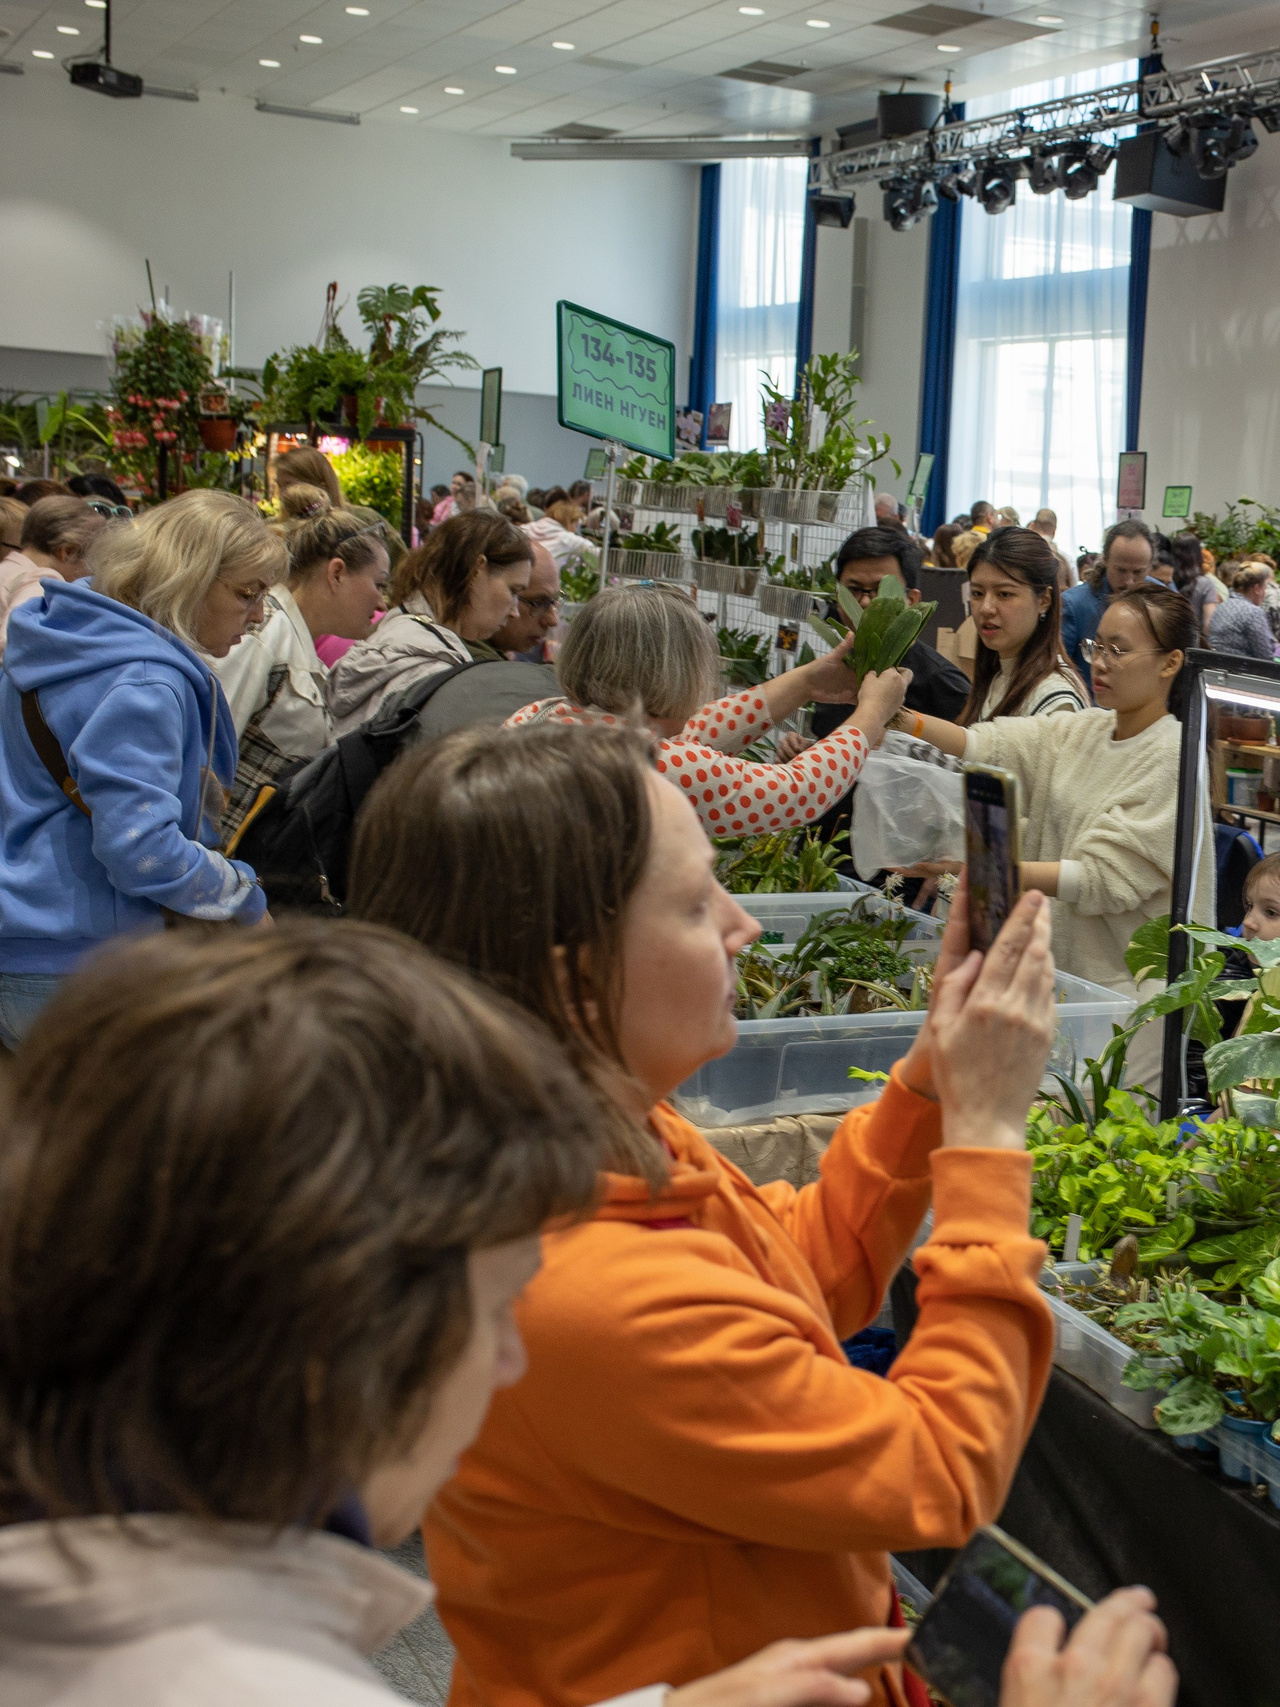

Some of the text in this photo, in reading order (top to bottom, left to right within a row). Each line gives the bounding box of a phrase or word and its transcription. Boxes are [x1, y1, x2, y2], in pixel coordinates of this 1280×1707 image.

[581, 333, 656, 382] 134-135
[573, 382, 666, 431] ЛИЕН НГУЕН
